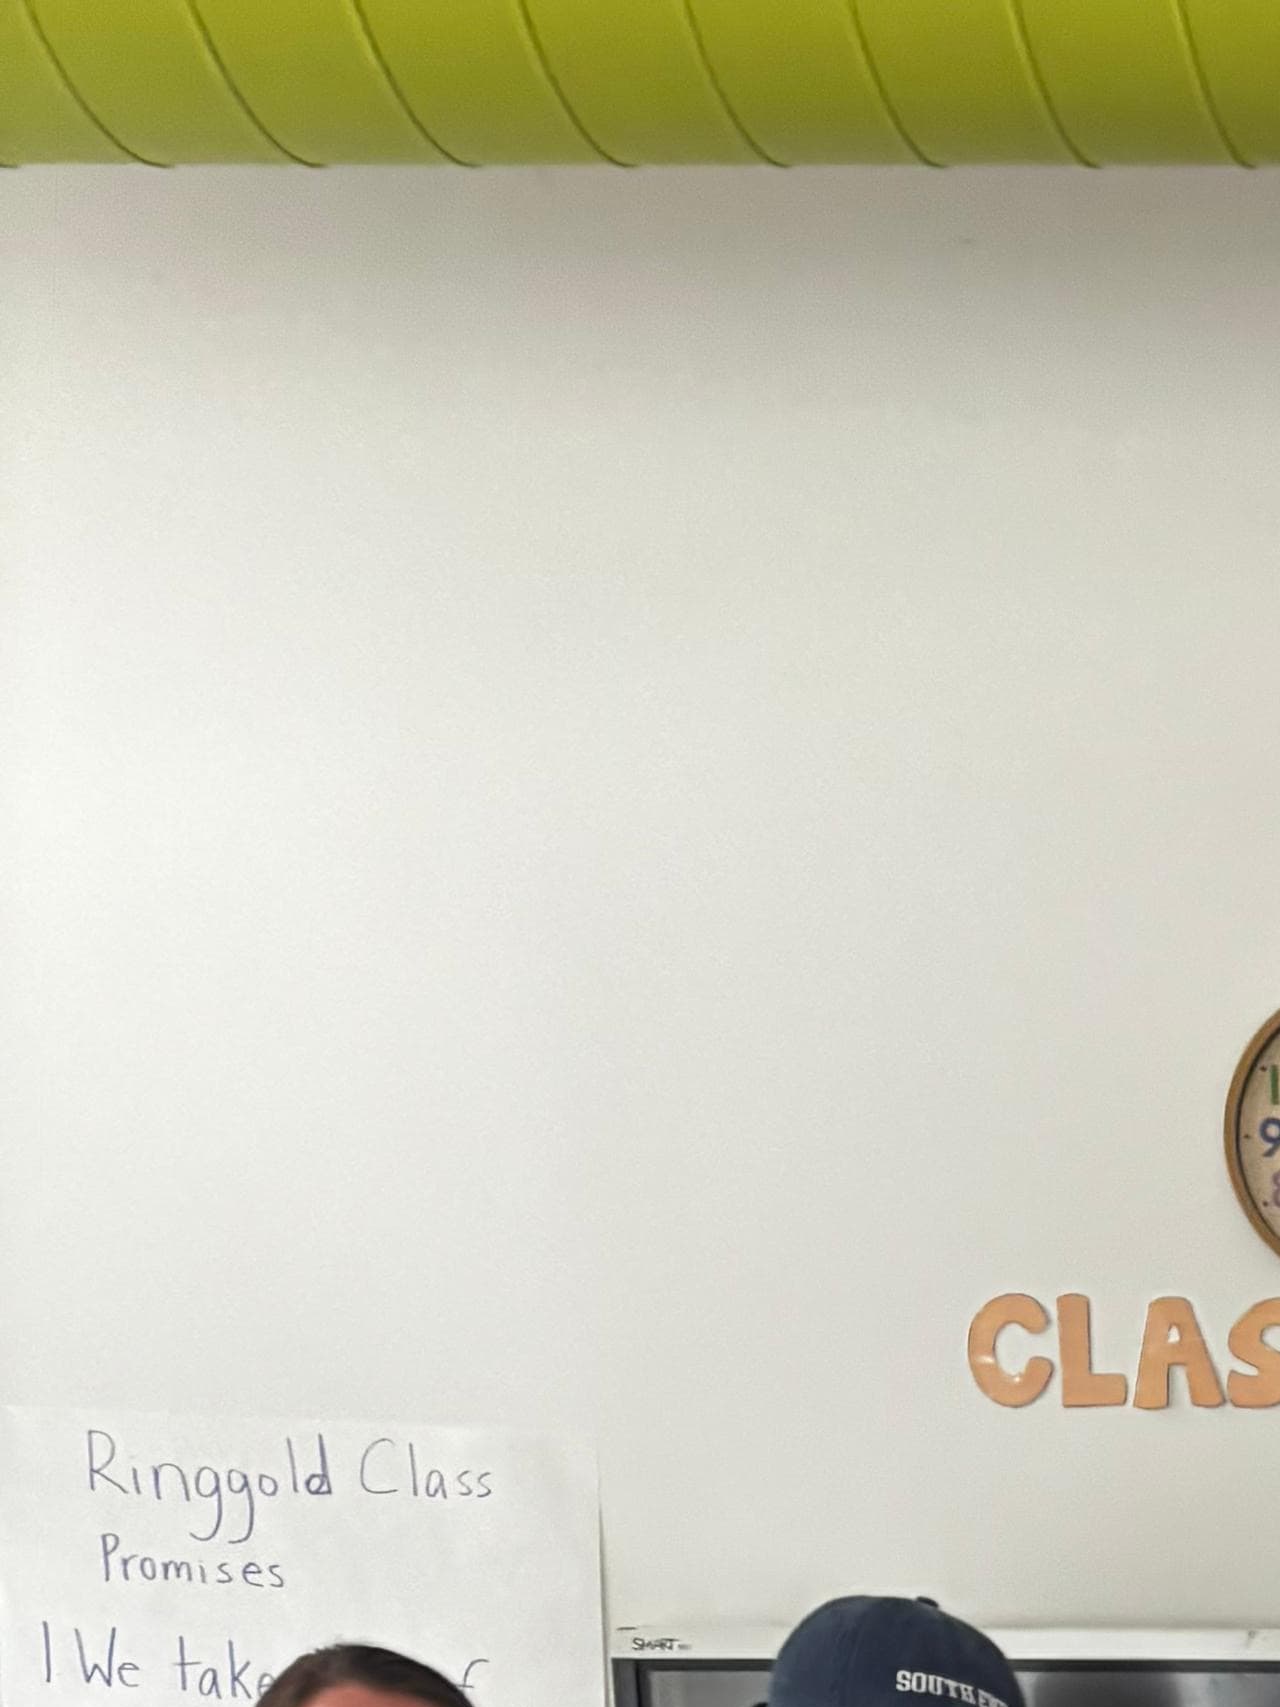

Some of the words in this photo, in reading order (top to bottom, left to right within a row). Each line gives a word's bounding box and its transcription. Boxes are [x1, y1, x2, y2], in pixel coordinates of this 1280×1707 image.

[88, 1429, 332, 1544] Ringgold
[360, 1437, 492, 1499] Class
[101, 1533, 285, 1588] Promises
[74, 1626, 141, 1688] We
[896, 1670, 976, 1705] SOUTH
